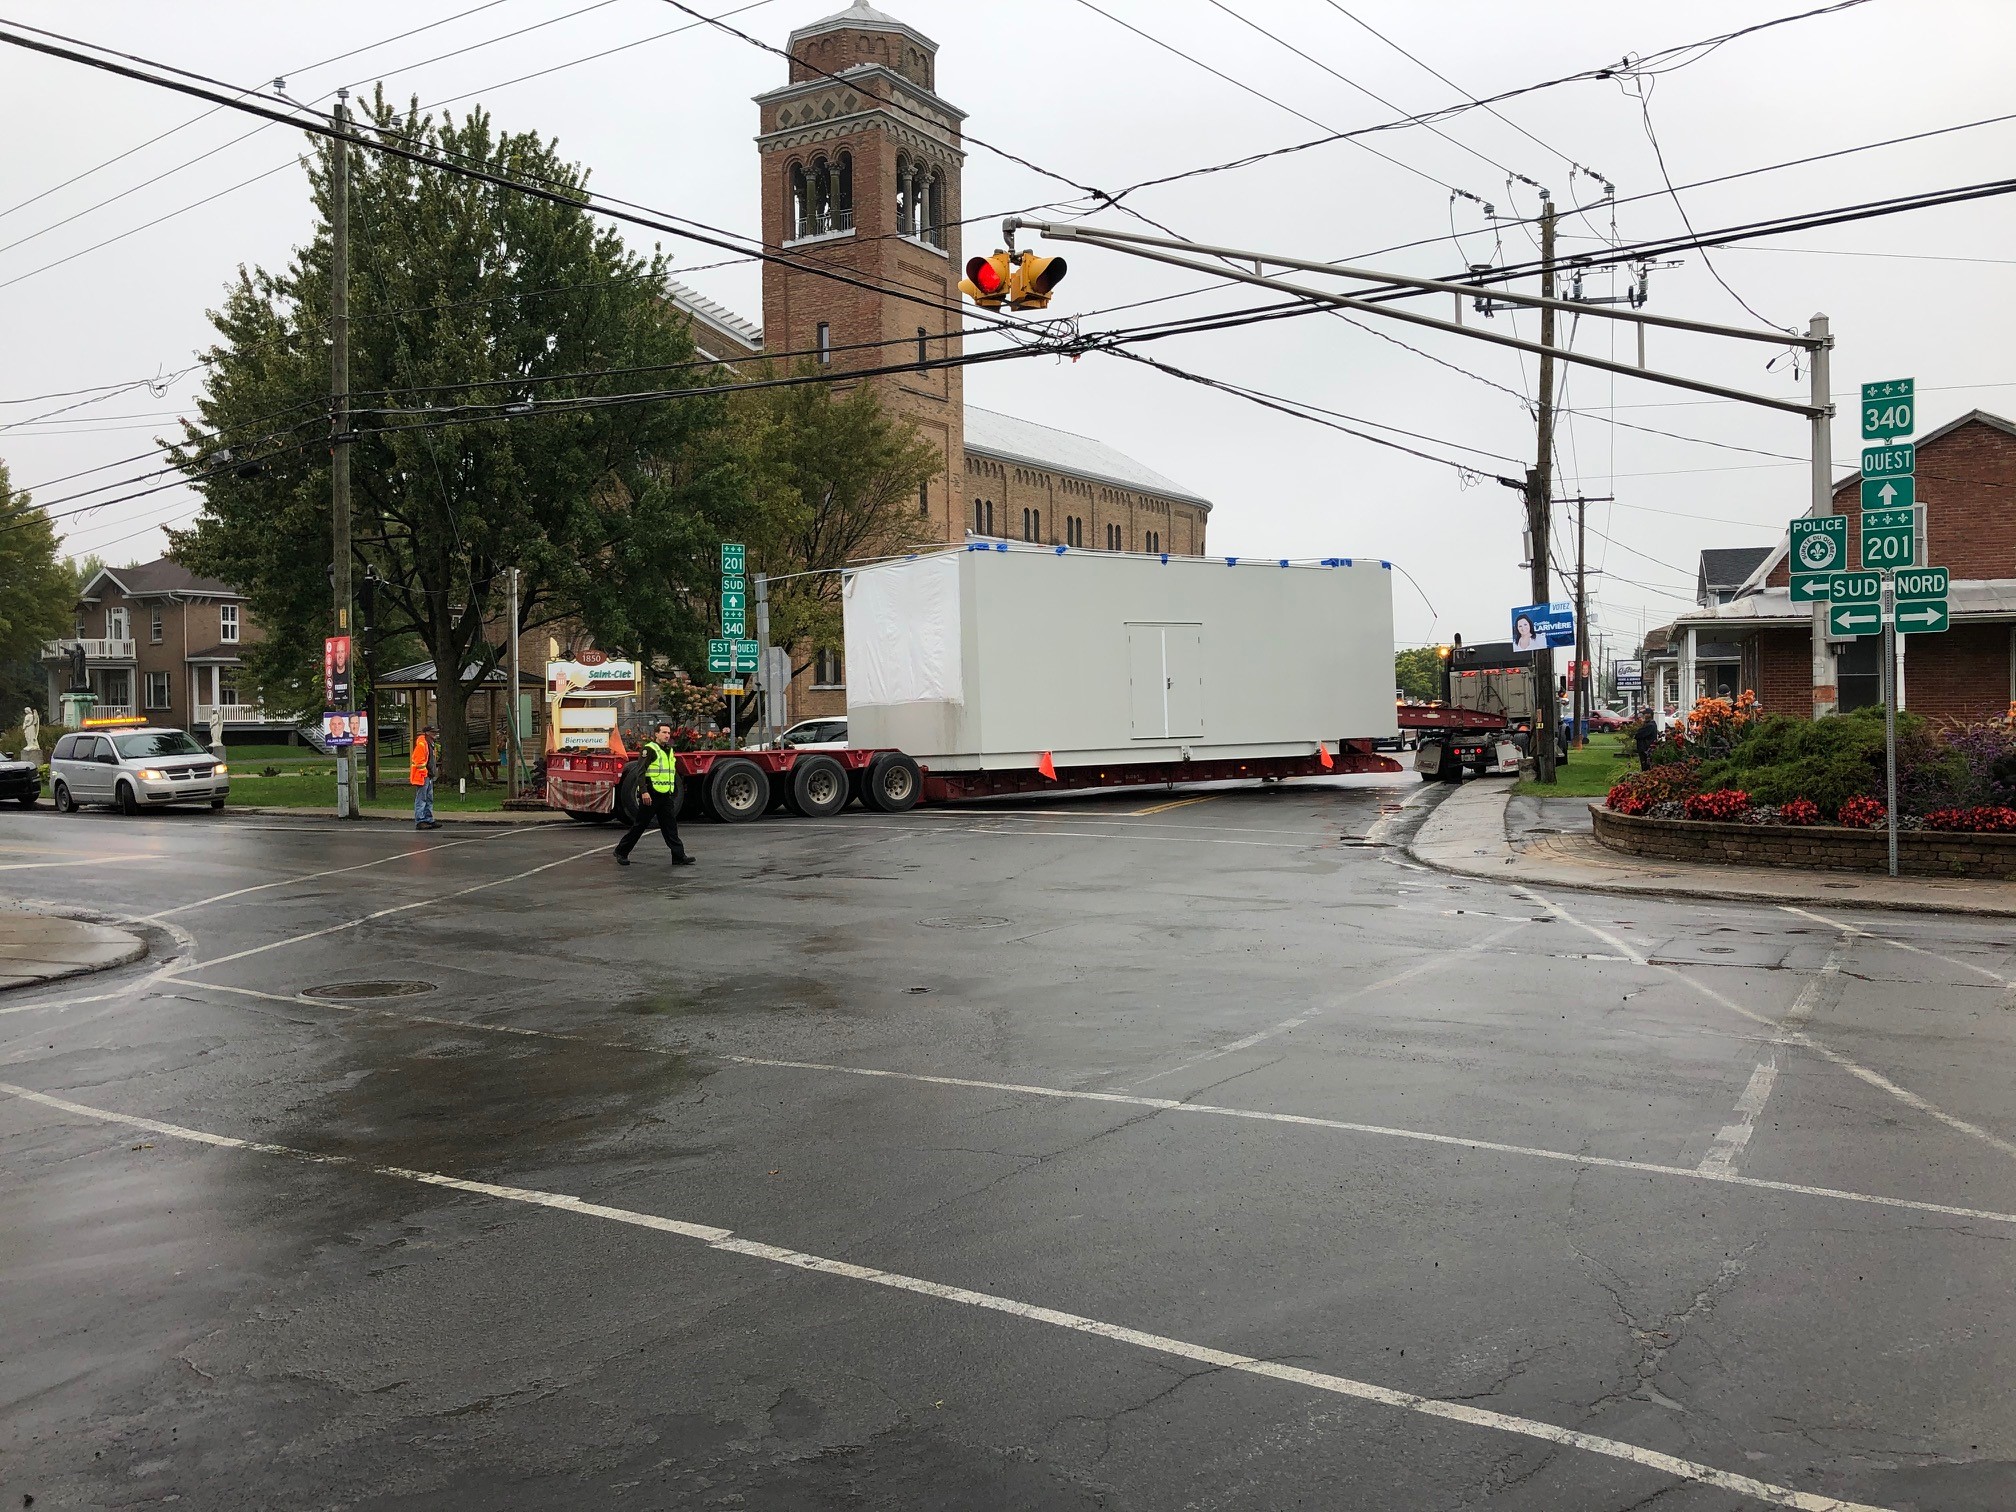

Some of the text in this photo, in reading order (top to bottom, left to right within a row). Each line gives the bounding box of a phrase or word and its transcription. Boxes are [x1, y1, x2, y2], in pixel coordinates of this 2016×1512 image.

[1865, 404, 1911, 431] 340
[1864, 450, 1912, 472] OUEST
[1793, 519, 1843, 533] POLICE
[1867, 535, 1909, 560] 201
[724, 557, 743, 570] 201
[723, 580, 744, 590] SUD
[1833, 578, 1878, 597] SUD
[1897, 574, 1945, 594] NORD
[1552, 602, 1570, 611] VOTEZ
[724, 622, 743, 635] 340
[1533, 621, 1572, 632] LARIVIÈRE
[711, 642, 729, 653] EST
[737, 643, 758, 653] OUEST
[582, 654, 602, 663] 1850
[588, 670, 632, 679] Saint-Clet
[564, 736, 604, 744] Bienvenue
